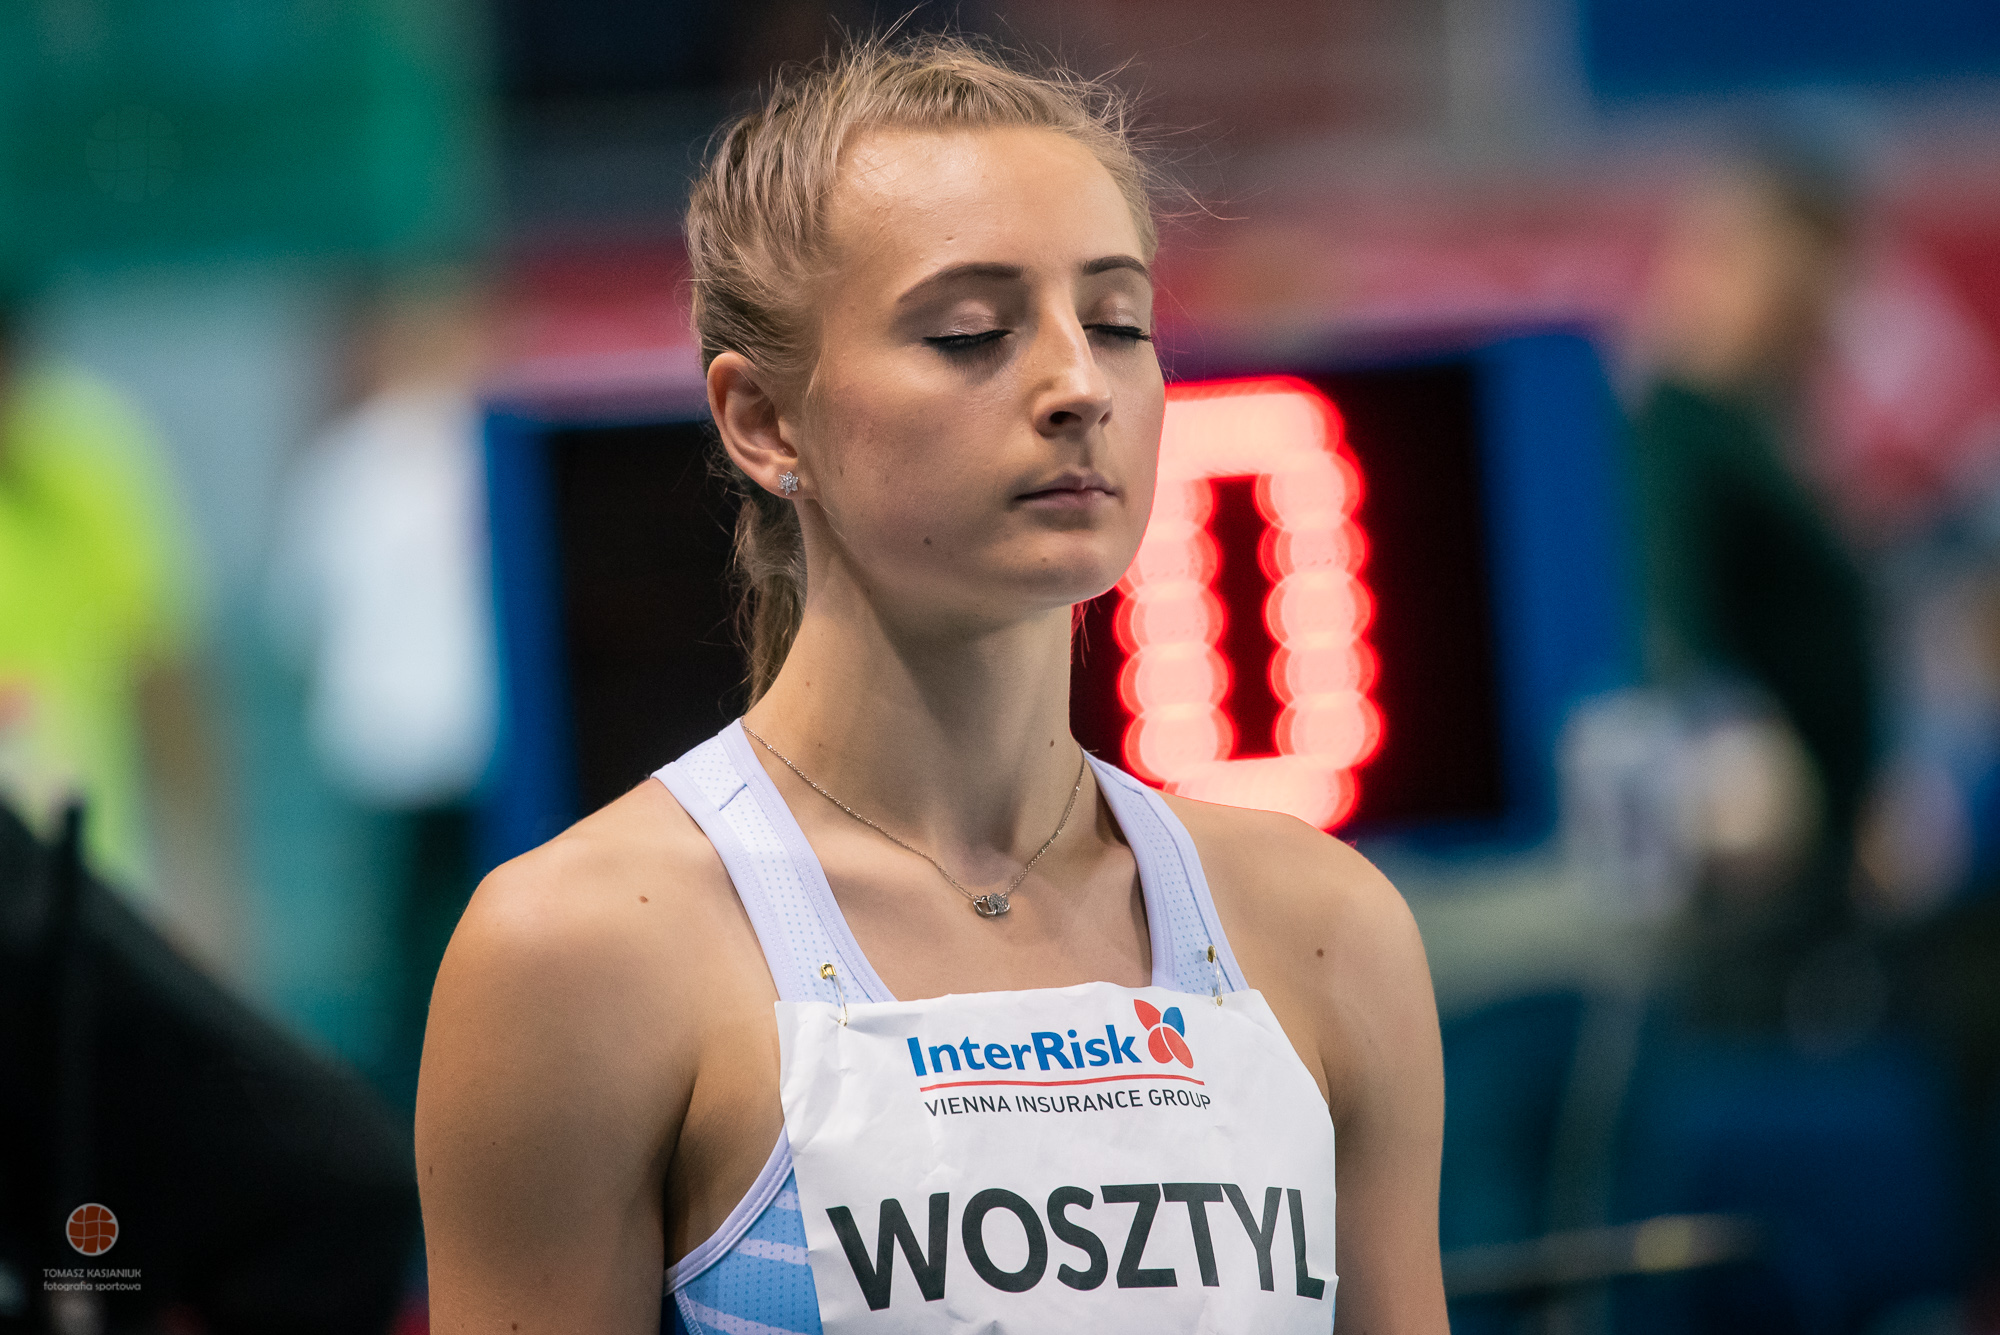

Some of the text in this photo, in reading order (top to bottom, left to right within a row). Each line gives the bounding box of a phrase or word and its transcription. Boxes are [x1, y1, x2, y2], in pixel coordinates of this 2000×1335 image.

[906, 1024, 1143, 1077] InterRisk
[924, 1088, 1212, 1117] VIENNA INSURANCE GROUP
[825, 1182, 1326, 1312] WOSZTYL
